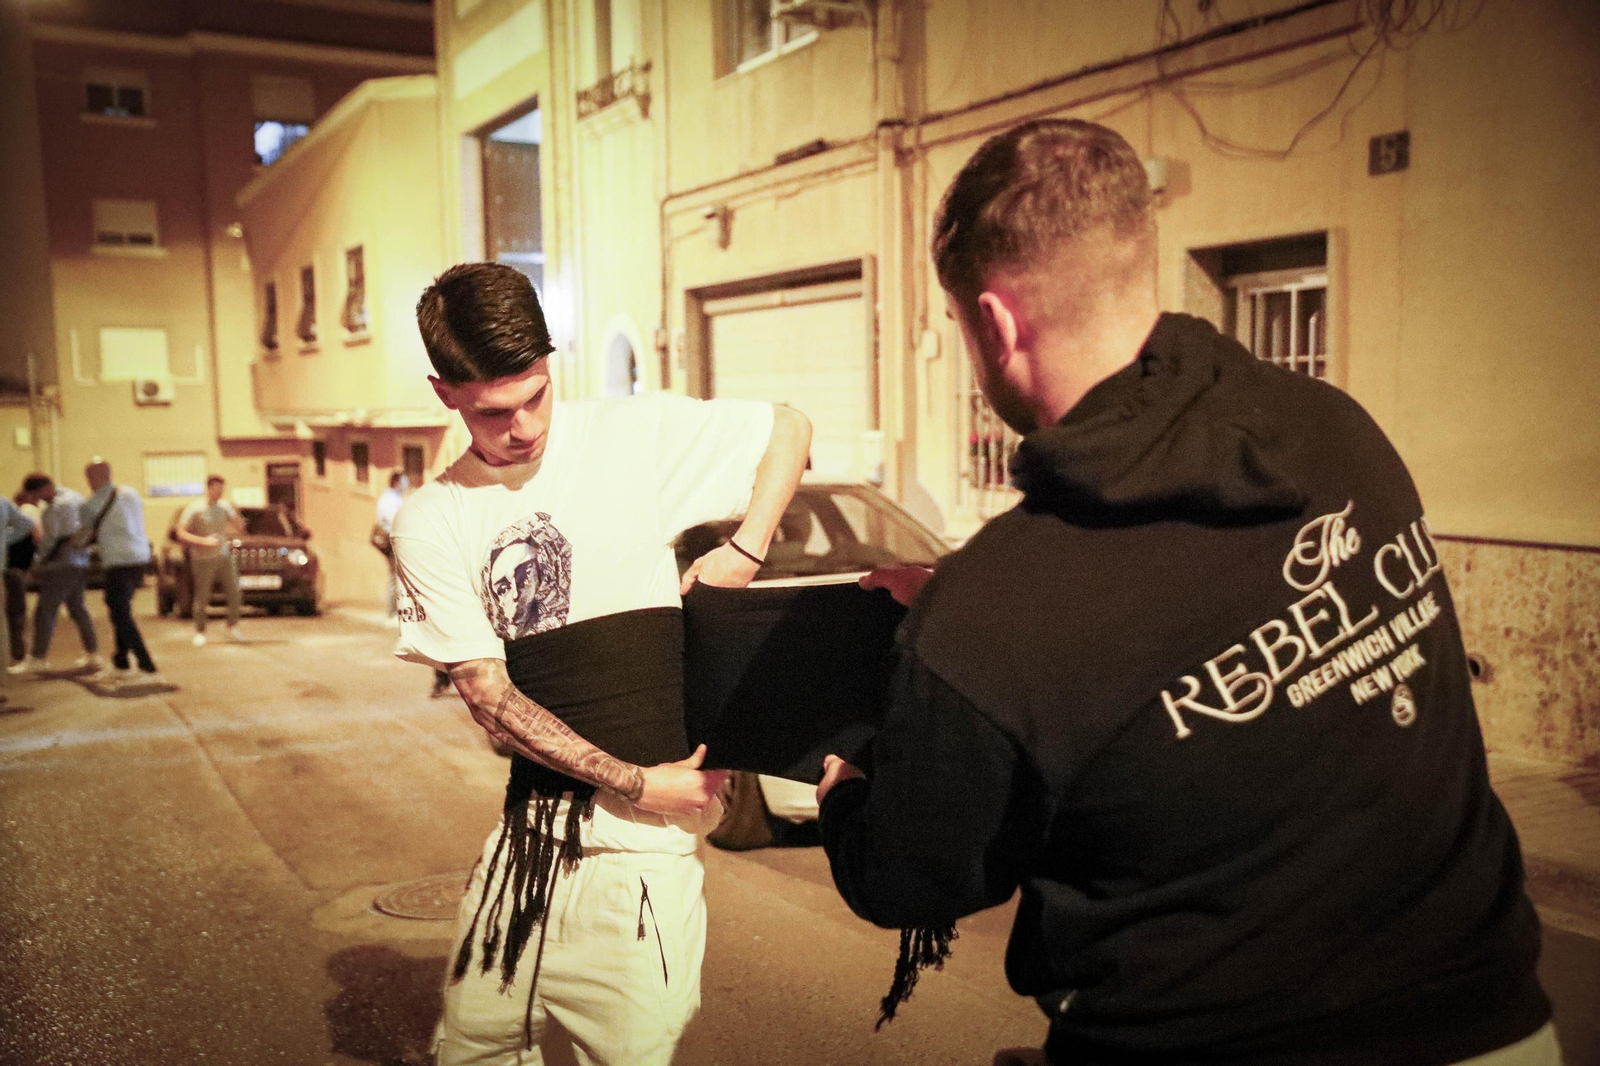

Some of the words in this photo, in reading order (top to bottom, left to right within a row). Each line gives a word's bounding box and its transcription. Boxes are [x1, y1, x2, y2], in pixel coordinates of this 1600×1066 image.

[1282, 499, 1362, 592] The
[1161, 580, 1379, 738] REBEL
[1286, 624, 1396, 708] GREENWICH
[1350, 664, 1394, 706] NEW
